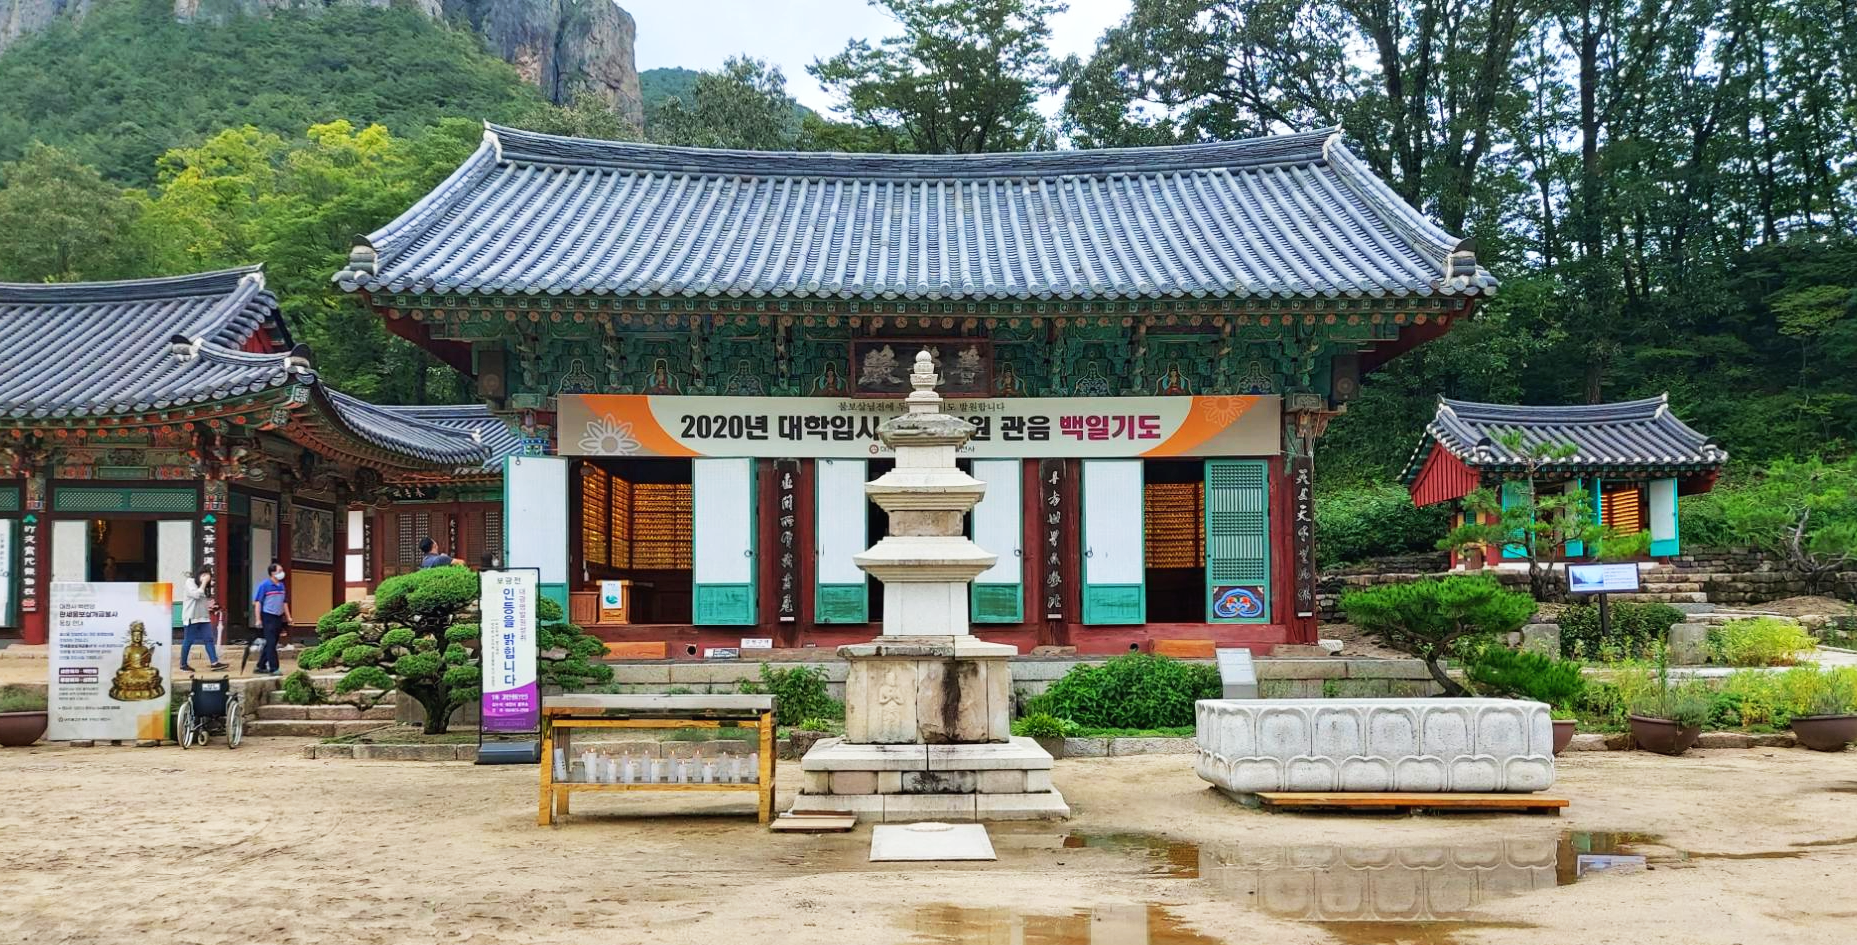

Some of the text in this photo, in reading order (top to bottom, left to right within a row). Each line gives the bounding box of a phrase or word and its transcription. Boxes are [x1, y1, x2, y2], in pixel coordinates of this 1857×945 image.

[959, 401, 1006, 412] 발원합니다
[680, 415, 769, 441] 2020년
[778, 415, 880, 441] 대학입시
[1000, 415, 1051, 441] 관음
[1059, 415, 1161, 441] 백일기도
[497, 576, 522, 585] 보광전
[502, 588, 517, 687] 인등을 밝힙니다
